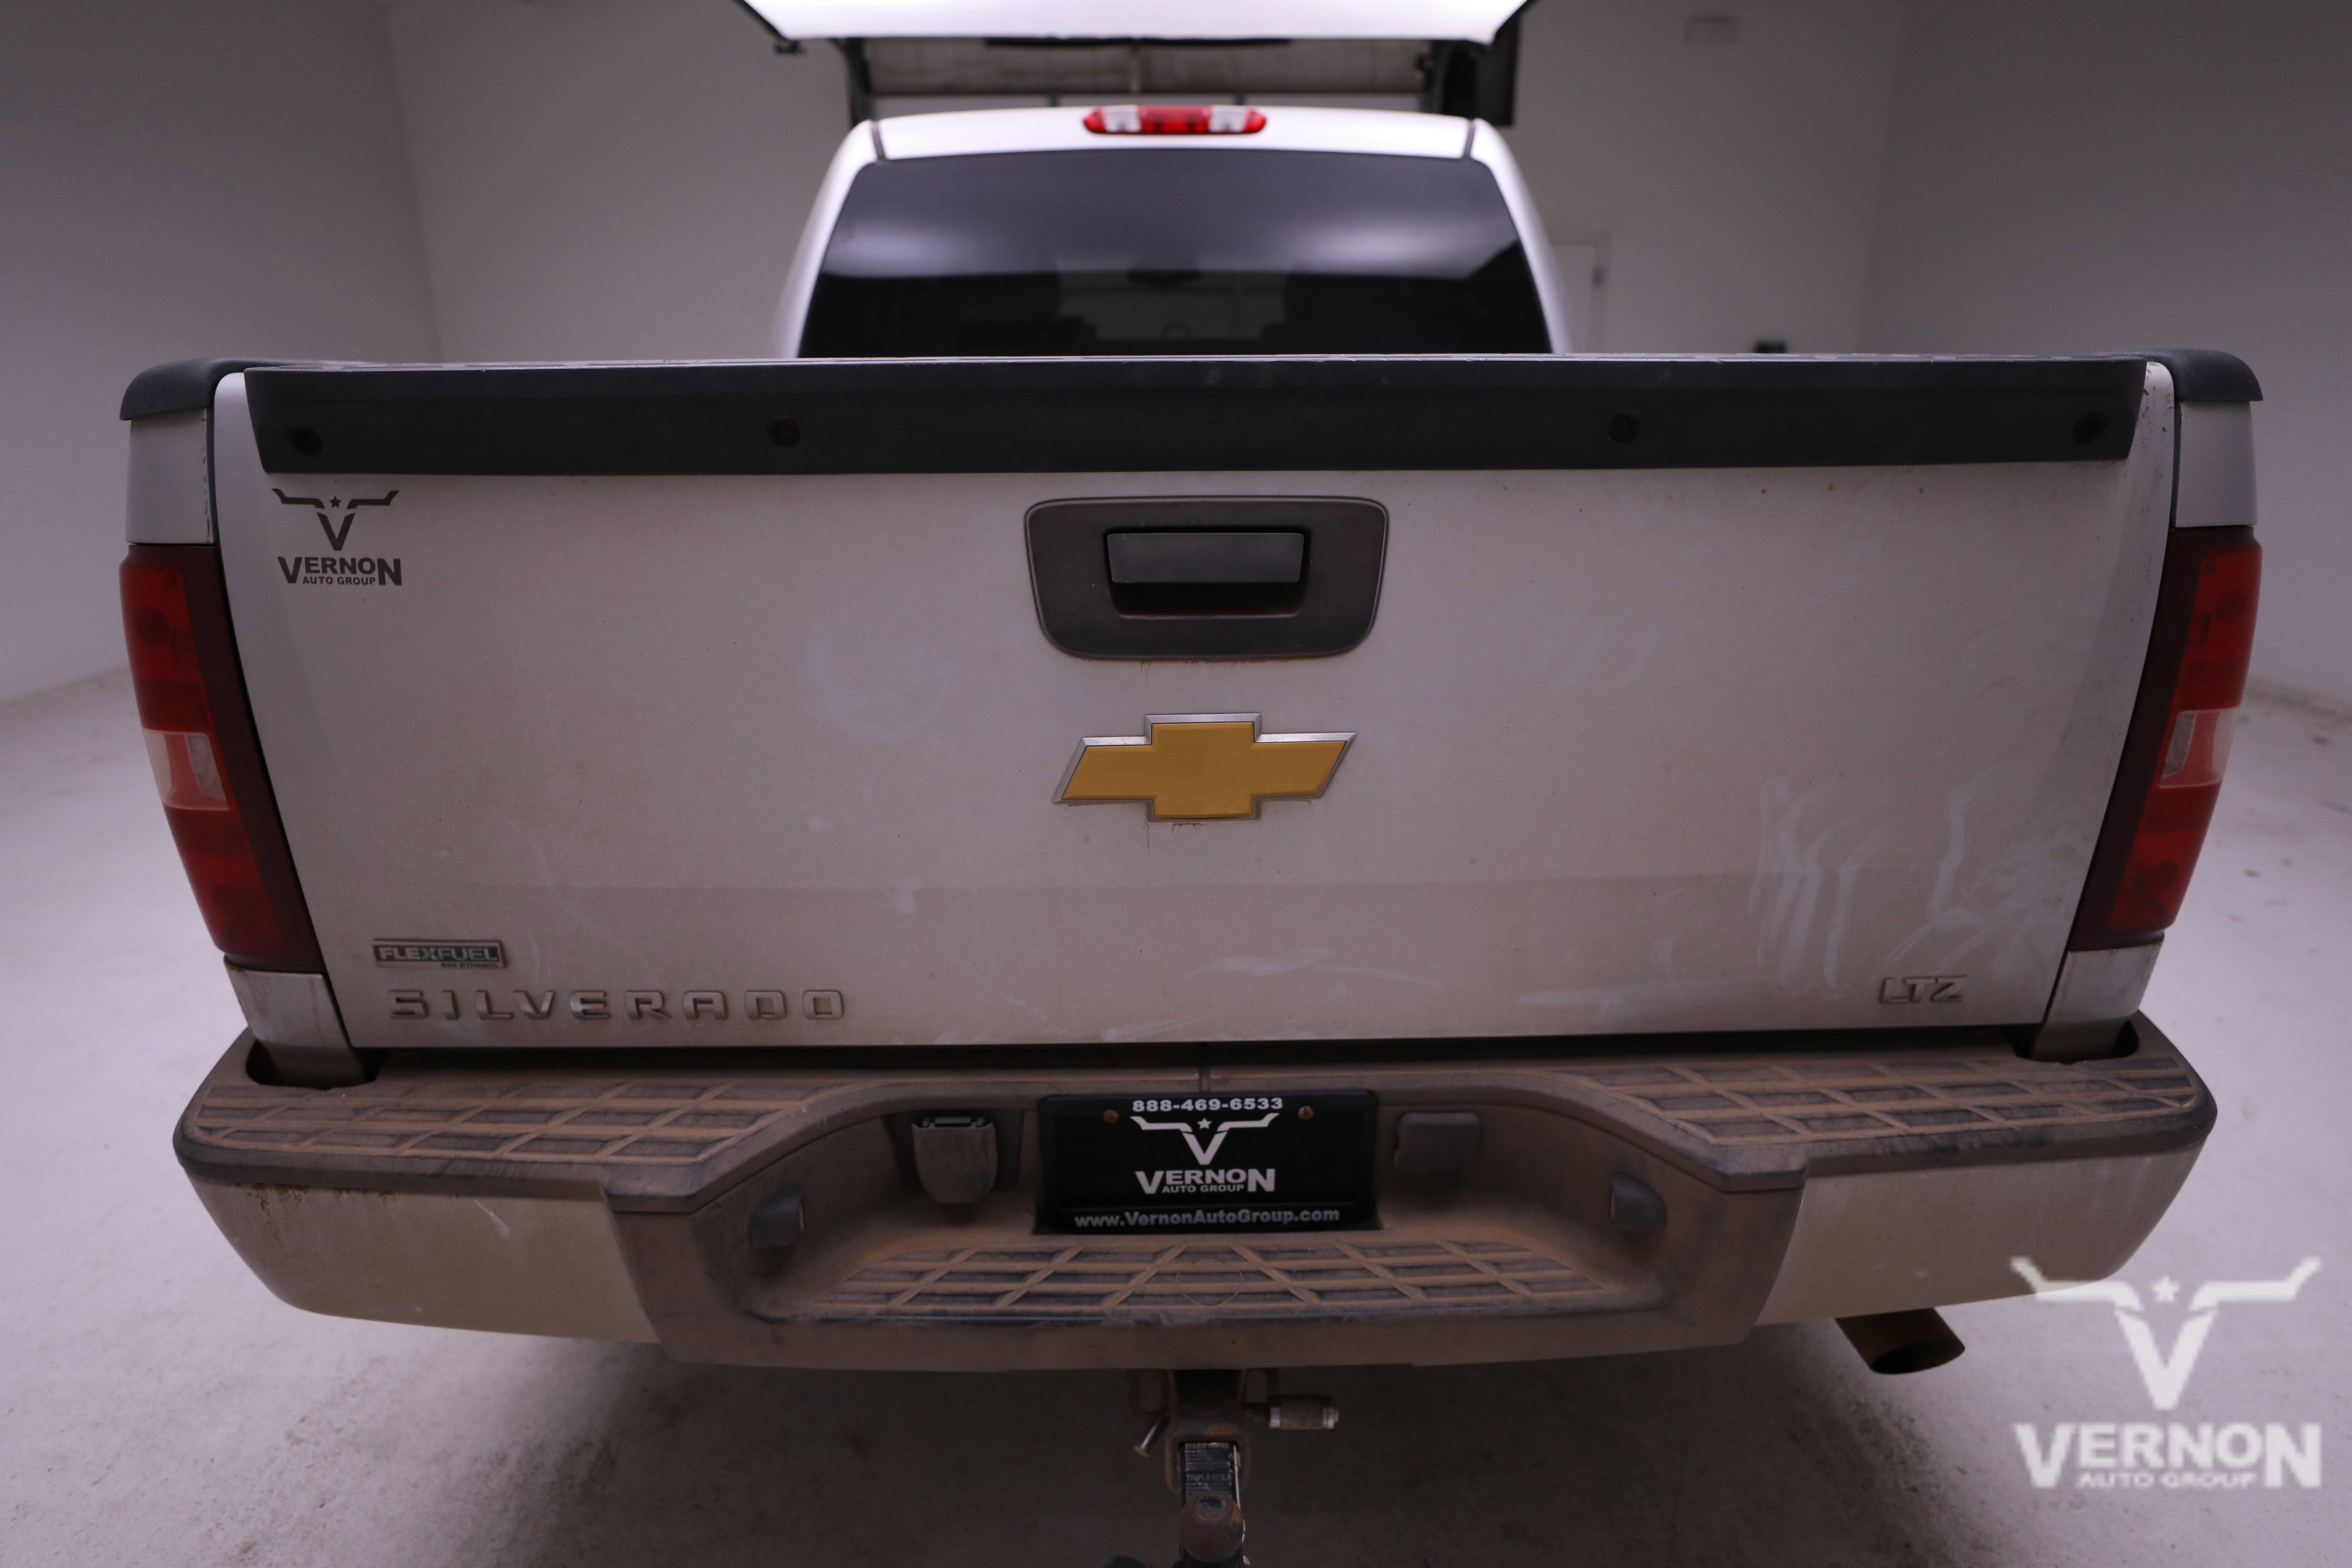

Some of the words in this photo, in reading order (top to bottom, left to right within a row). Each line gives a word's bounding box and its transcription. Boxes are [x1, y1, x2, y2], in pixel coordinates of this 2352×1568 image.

[277, 556, 403, 586] VERNON
[337, 577, 376, 585] GROUP
[378, 946, 498, 961] FLEXFUEL
[1878, 974, 1967, 1004] LTZ
[388, 989, 846, 1021] SILVERADO
[1132, 1097, 1283, 1112] 888-469-6533
[1135, 1168, 1276, 1195] VERNON
[1162, 1185, 1198, 1193] AUTO
[1200, 1184, 1245, 1193] GROUP
[1075, 1208, 1340, 1227] www.VernonAutoGroup.com
